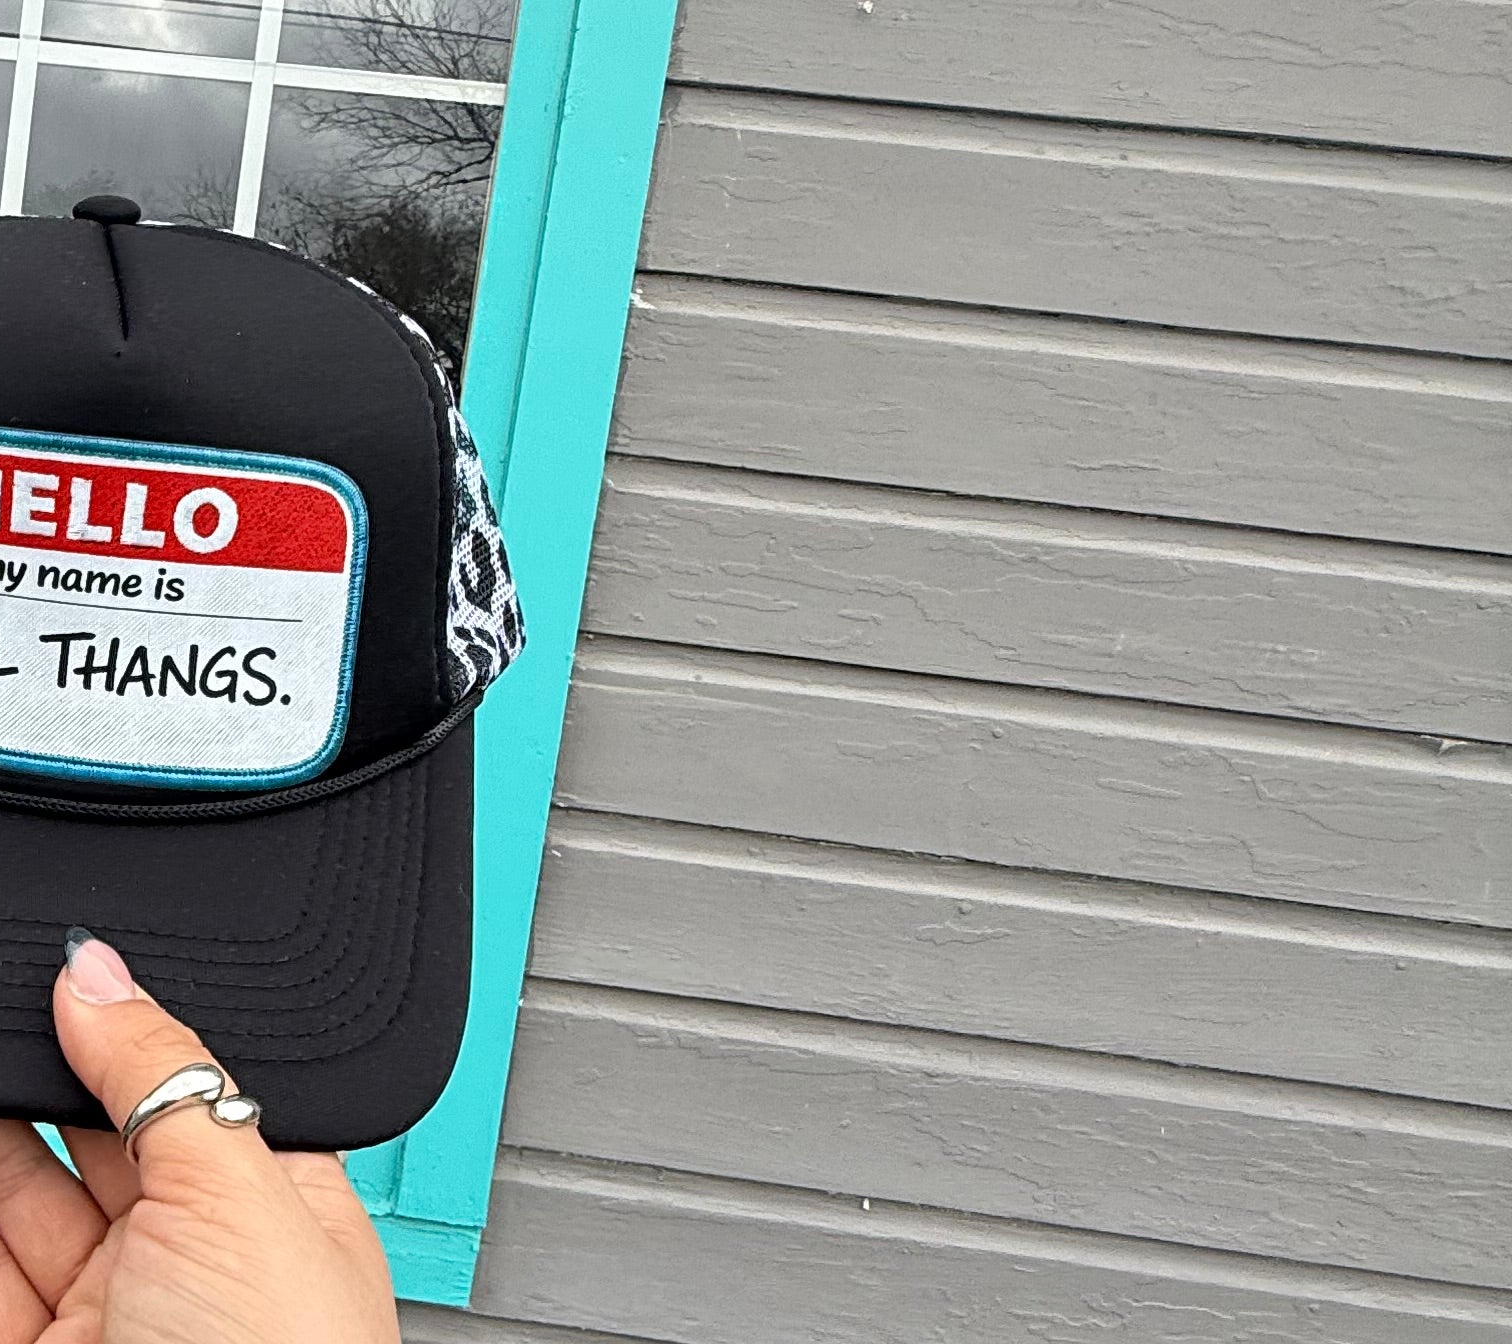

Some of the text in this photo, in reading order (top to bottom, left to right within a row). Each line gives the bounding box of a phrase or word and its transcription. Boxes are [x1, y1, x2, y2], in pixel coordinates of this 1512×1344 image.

[37, 564, 143, 598] name
[154, 567, 185, 602] is
[38, 631, 292, 707] THANGS.
